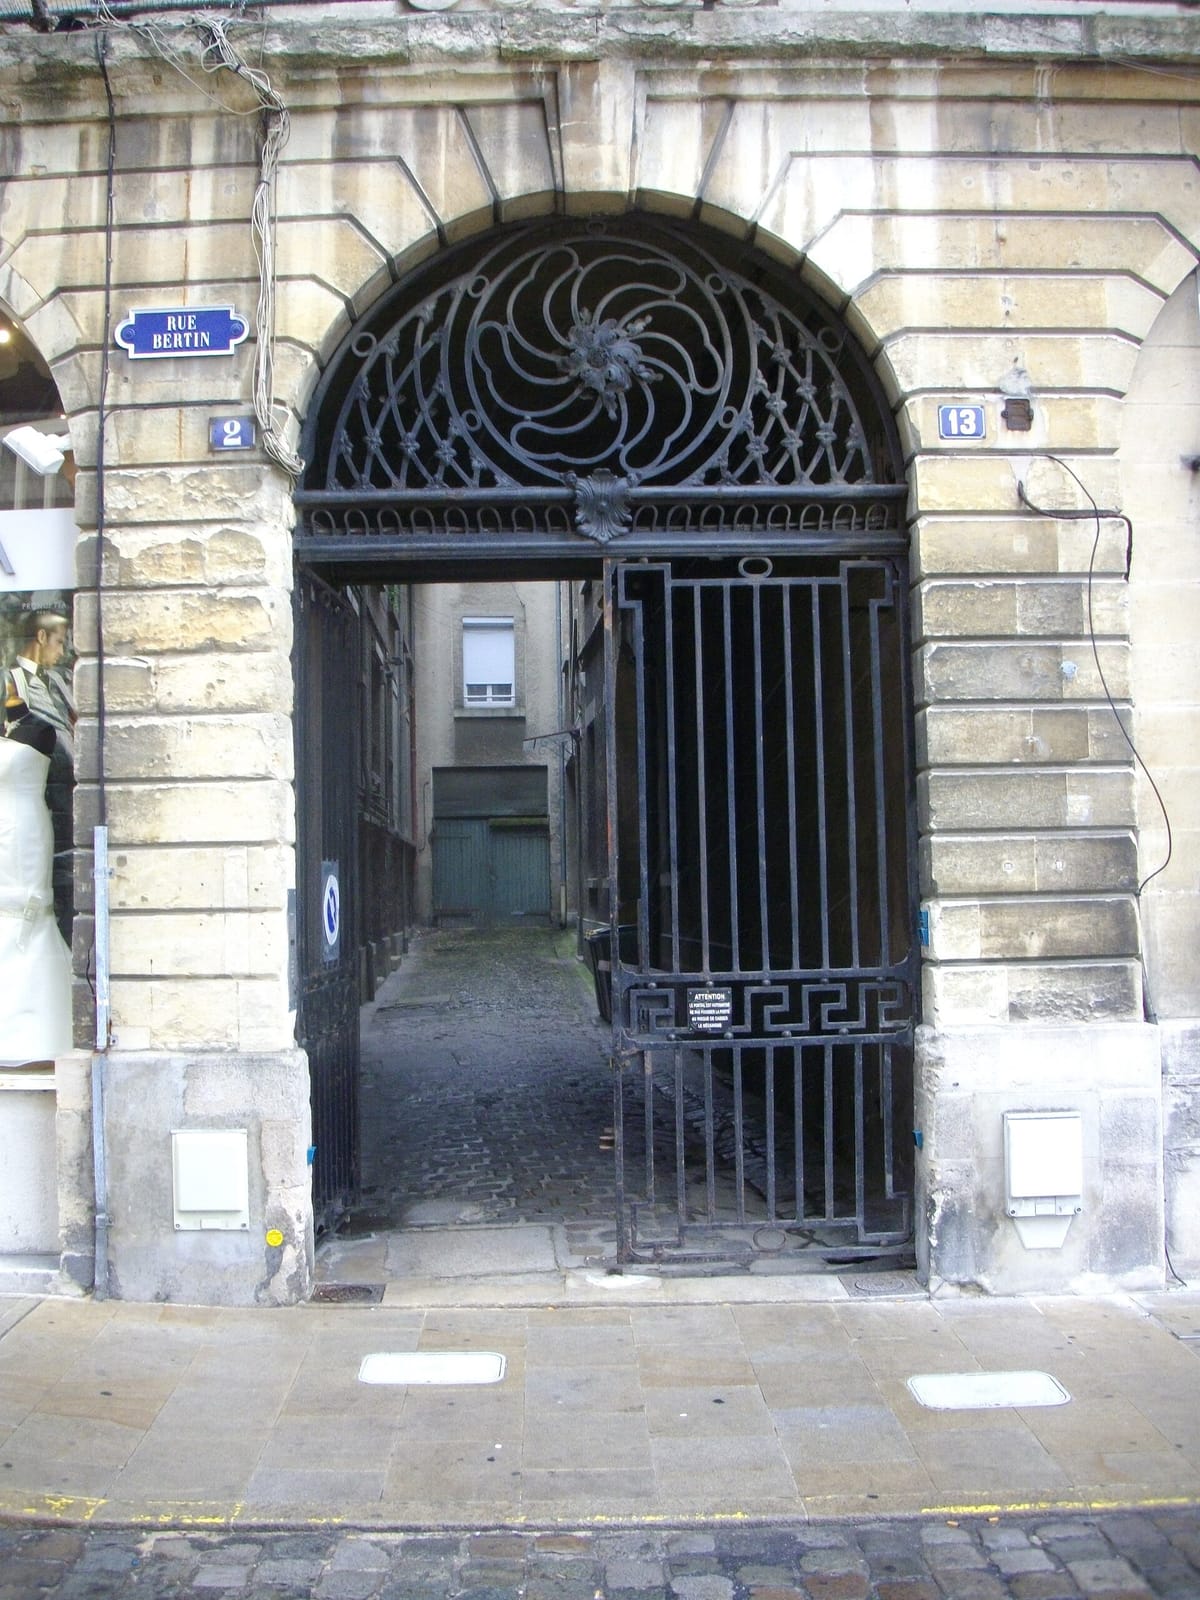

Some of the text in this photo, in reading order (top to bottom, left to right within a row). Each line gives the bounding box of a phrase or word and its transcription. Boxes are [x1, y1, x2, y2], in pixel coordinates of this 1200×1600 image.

[167, 315, 197, 331] RUE
[152, 331, 210, 349] BERTIN
[223, 419, 242, 446] 2
[948, 408, 976, 435] 13
